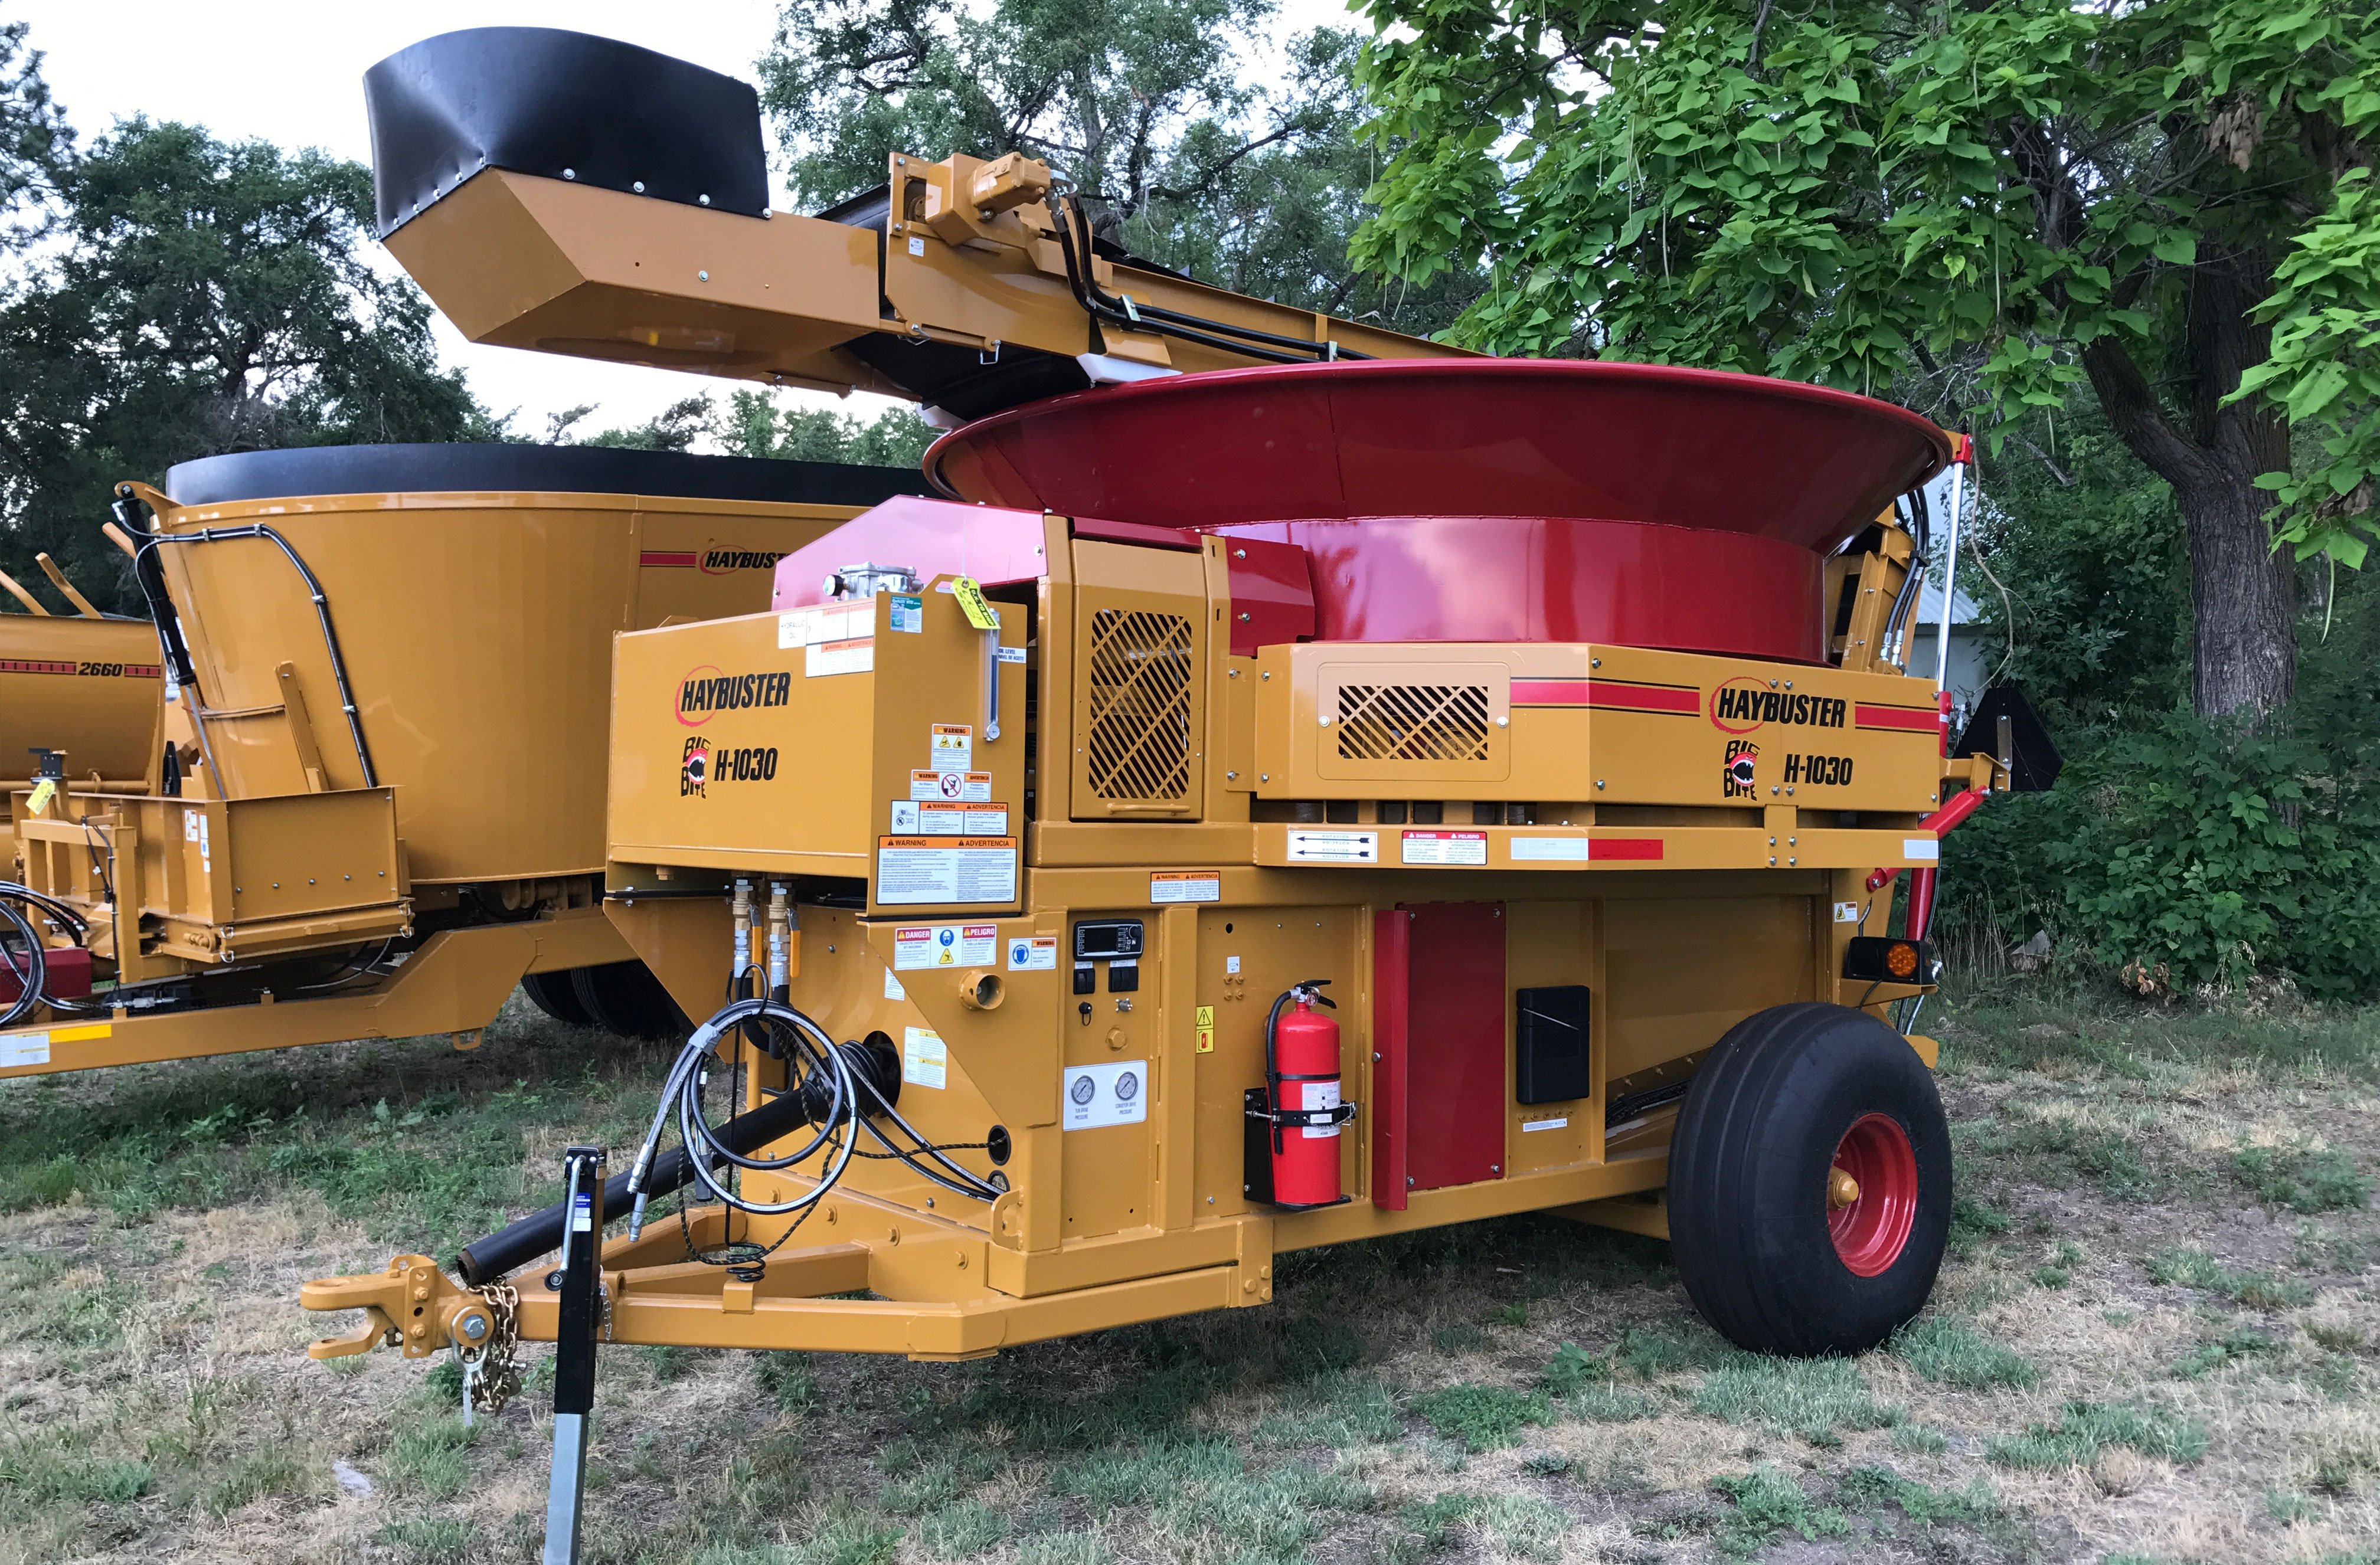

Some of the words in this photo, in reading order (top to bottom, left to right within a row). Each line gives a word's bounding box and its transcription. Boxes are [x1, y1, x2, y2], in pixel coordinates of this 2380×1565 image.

[705, 552, 791, 568] HAYBUST
[983, 611, 995, 626] SHIP
[78, 662, 123, 677] 2660
[681, 672, 791, 712] HAYBUSTER
[1718, 688, 1846, 728] HAYBUSTER
[682, 736, 711, 763] BIG
[714, 747, 778, 781] H-1030
[1724, 739, 1761, 765] BIG
[681, 766, 707, 800] BITE
[1723, 767, 1757, 802] BITE
[1783, 754, 1853, 785] H-1030
